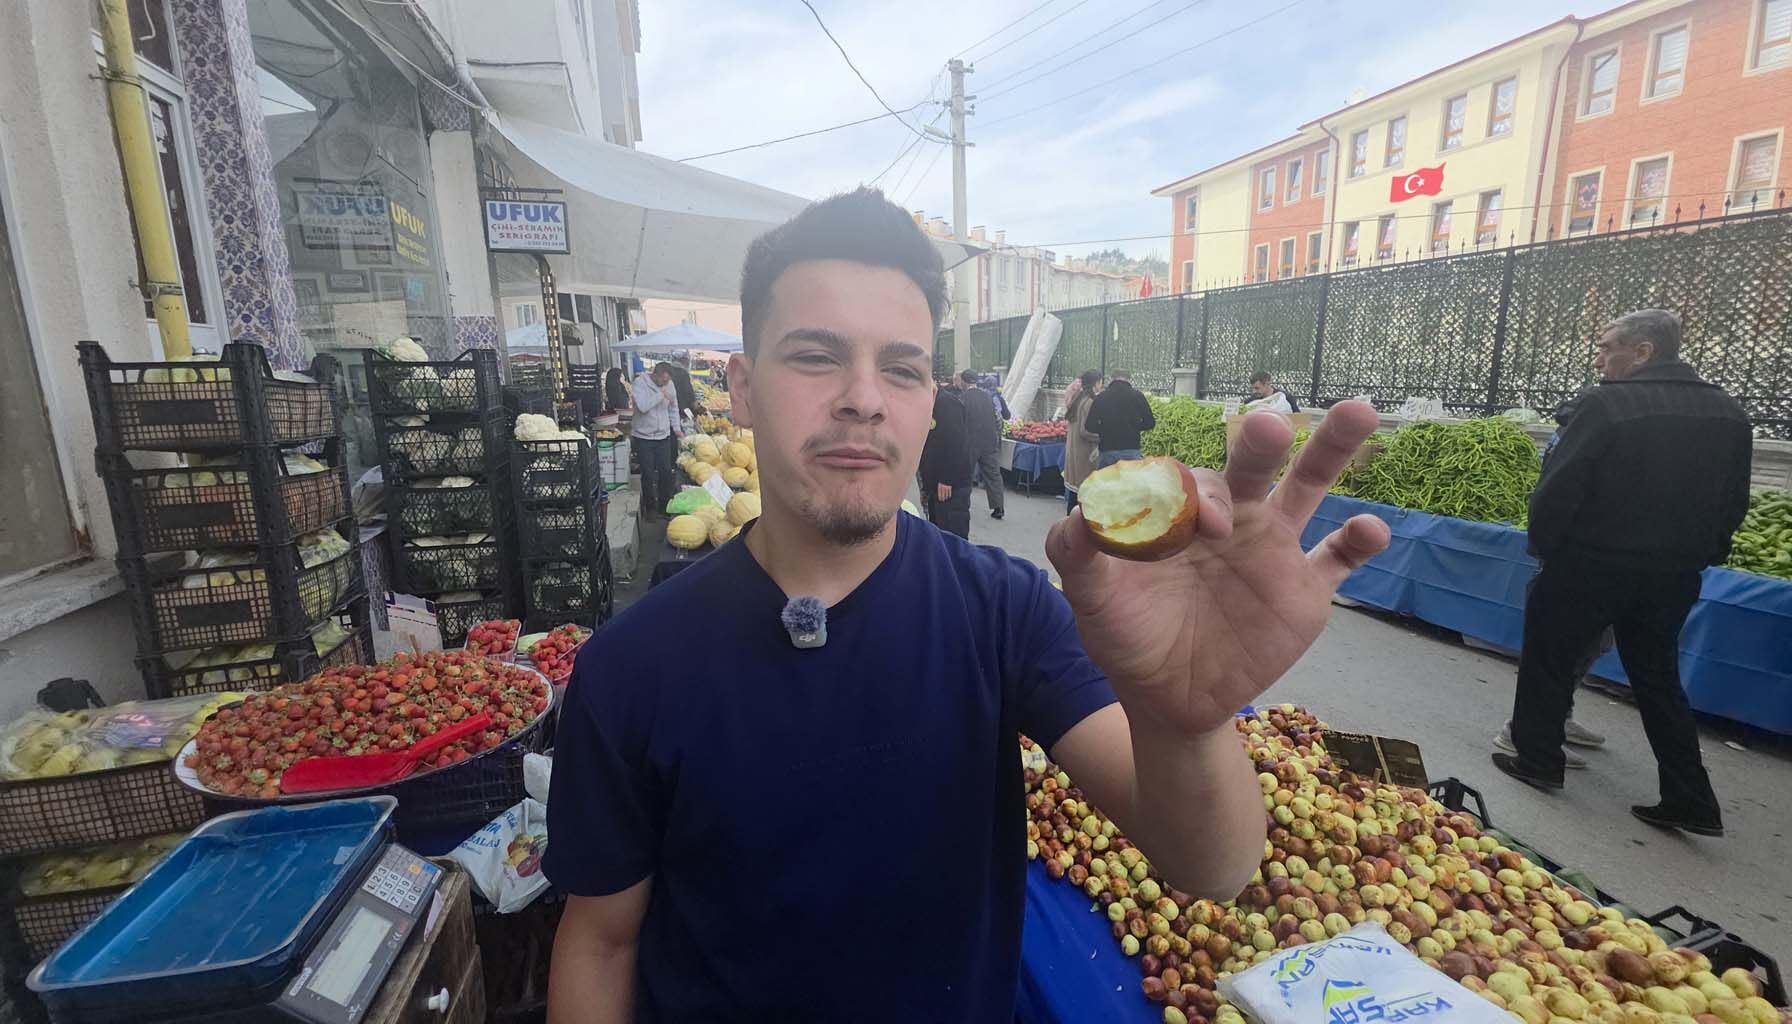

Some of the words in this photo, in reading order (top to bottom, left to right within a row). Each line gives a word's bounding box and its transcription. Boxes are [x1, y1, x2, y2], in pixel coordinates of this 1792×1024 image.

[390, 200, 427, 239] UFUK
[489, 203, 561, 223] UFUK
[373, 875, 382, 883] 2
[378, 866, 387, 875] 3
[384, 881, 393, 890] 5
[390, 873, 399, 881] 6
[390, 896, 399, 904] 7
[396, 888, 405, 896] 8
[402, 880, 410, 888] 9
[408, 894, 417, 903] 0
